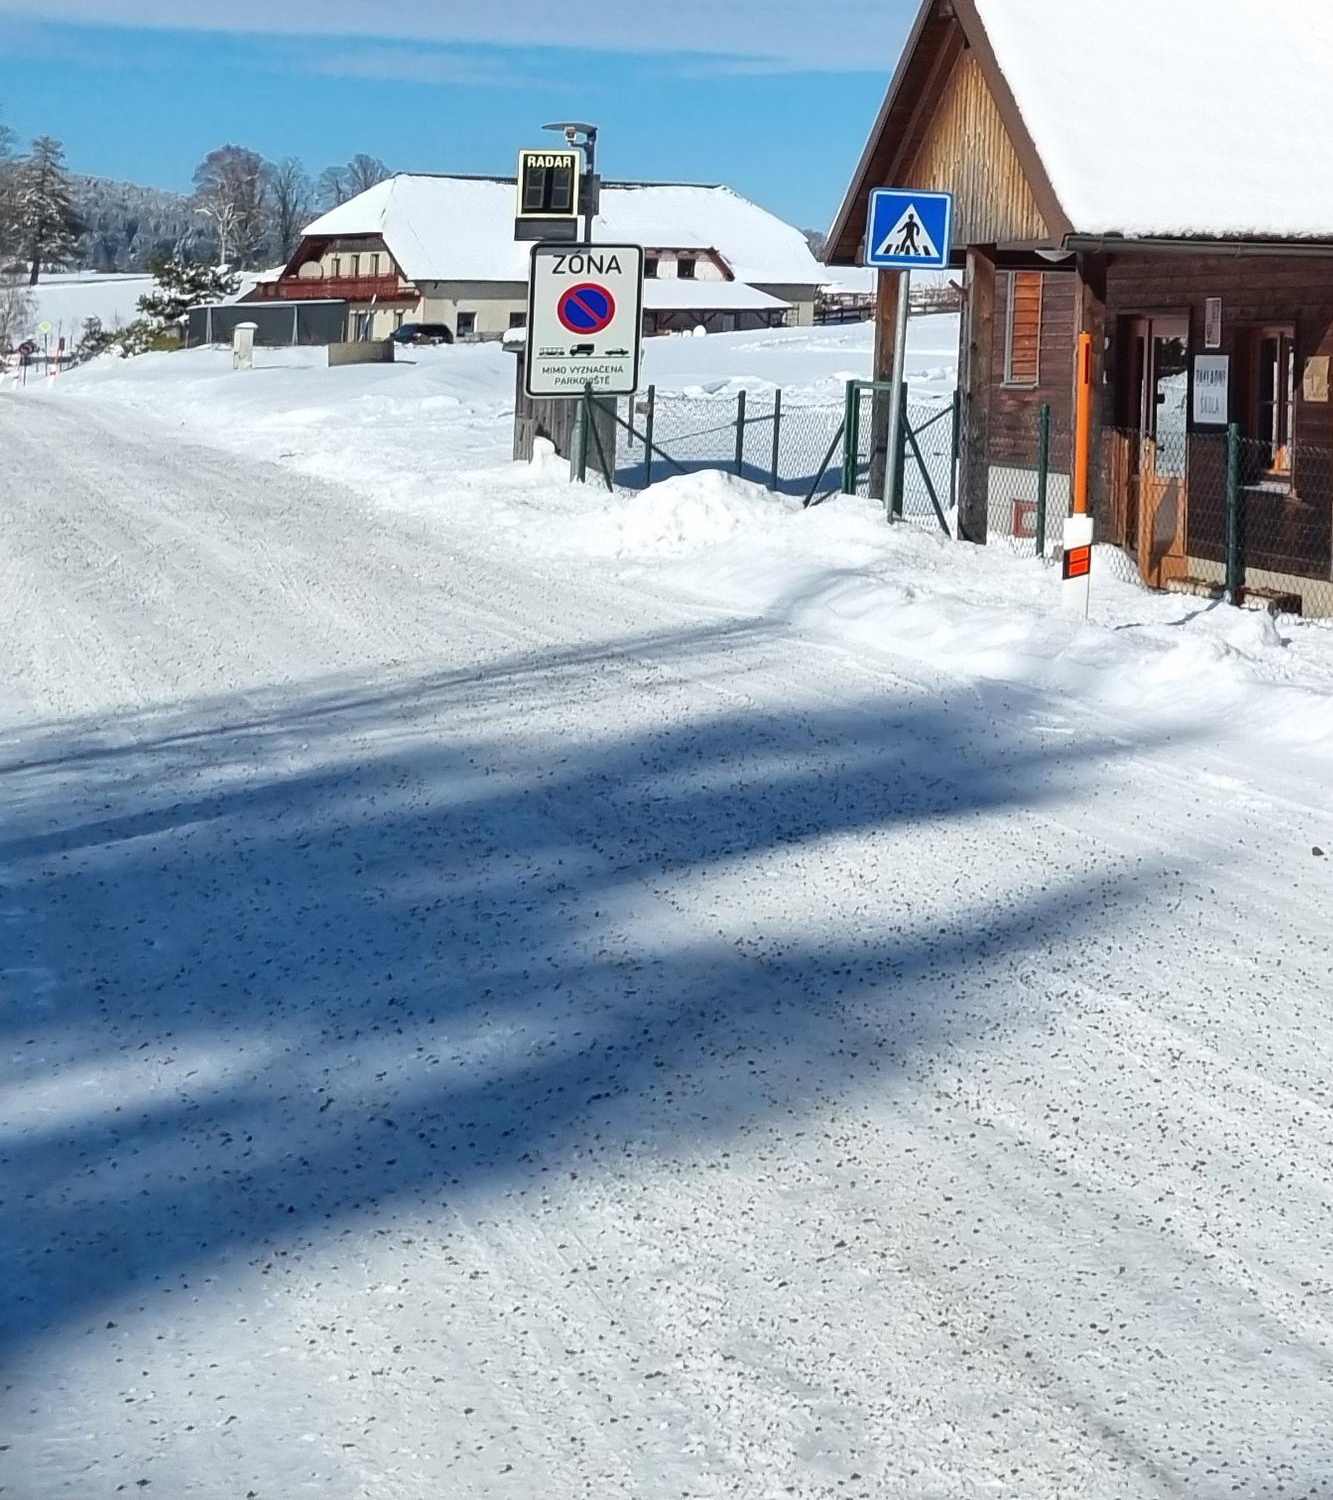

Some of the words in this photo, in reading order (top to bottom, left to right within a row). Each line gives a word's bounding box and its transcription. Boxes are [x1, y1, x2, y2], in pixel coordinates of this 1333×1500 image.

[527, 155, 572, 168] RADAR
[552, 250, 622, 274] ZÓNA
[542, 366, 567, 374] MIMO
